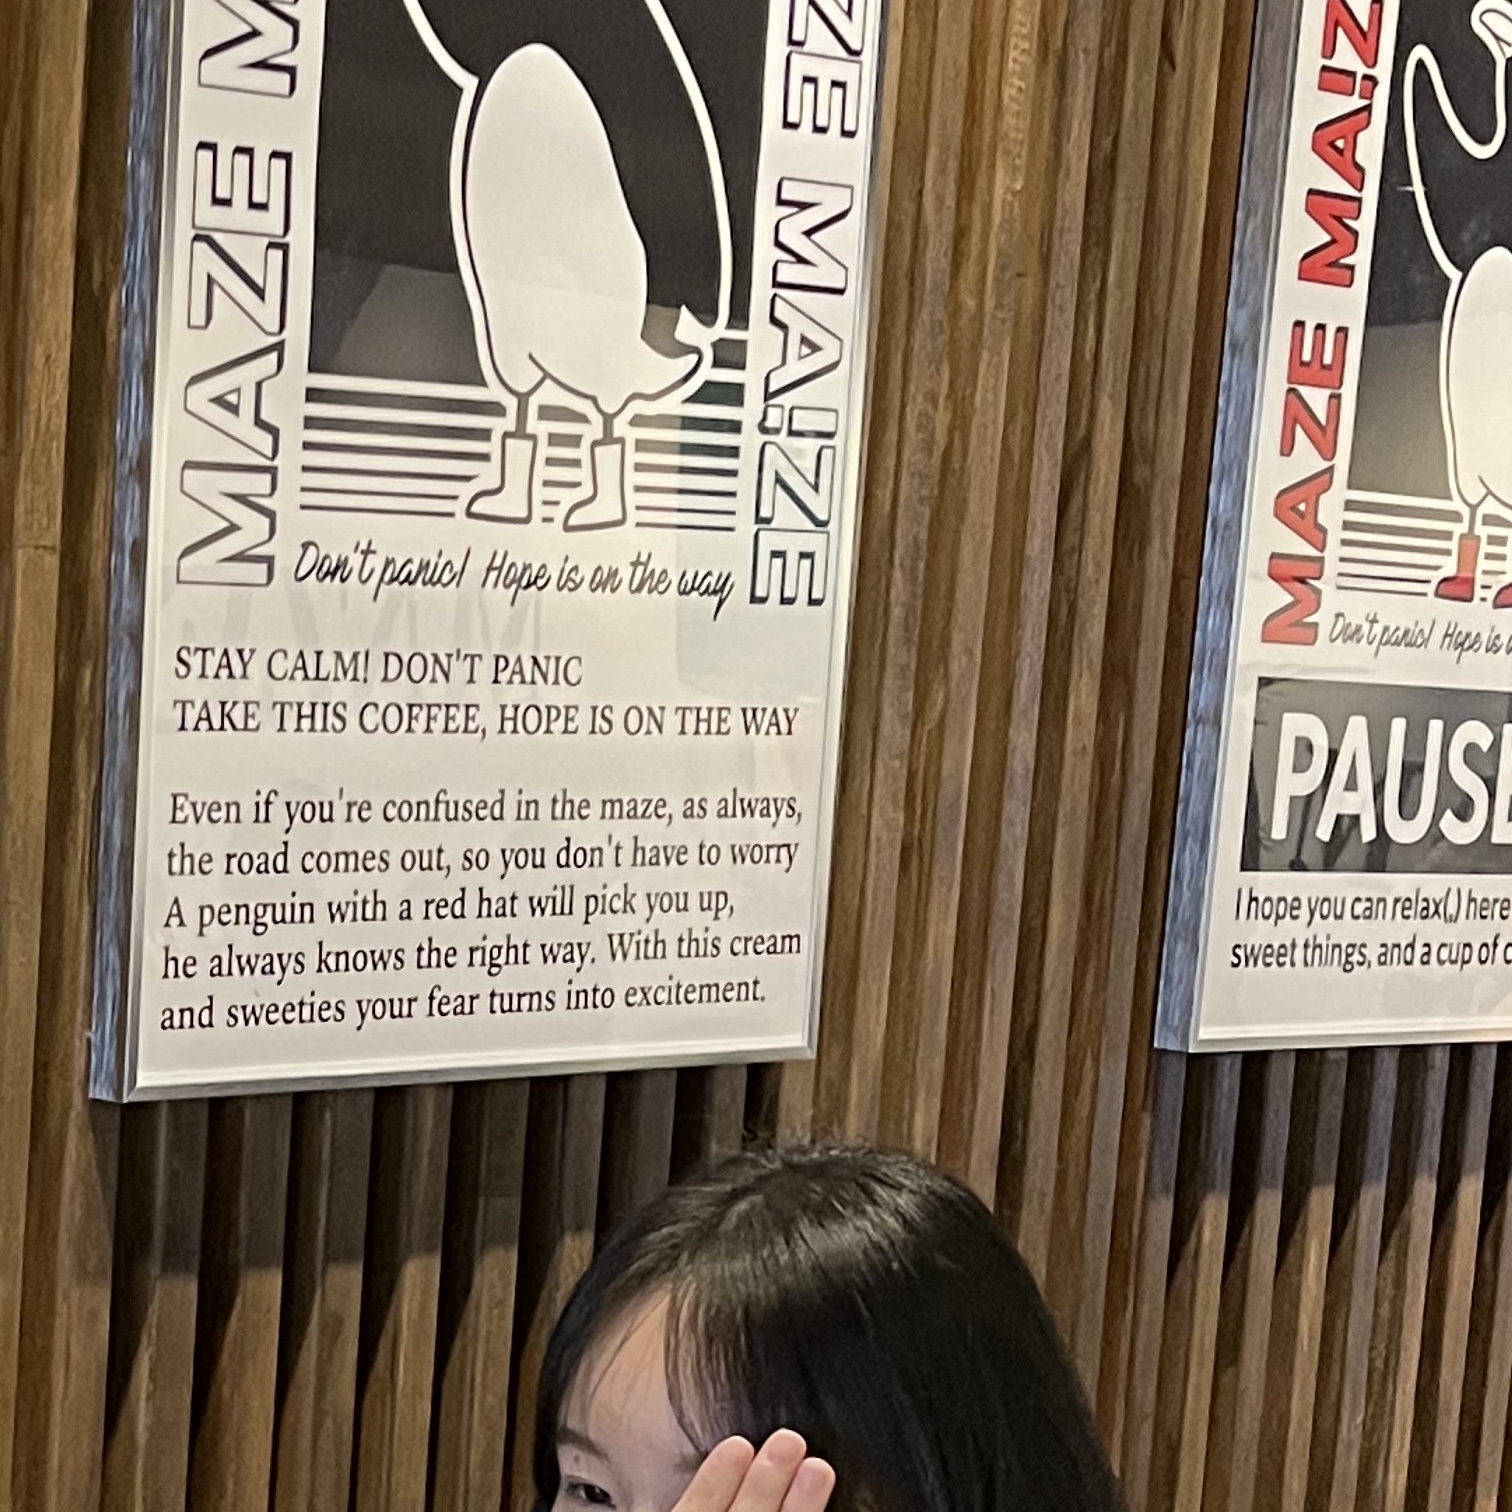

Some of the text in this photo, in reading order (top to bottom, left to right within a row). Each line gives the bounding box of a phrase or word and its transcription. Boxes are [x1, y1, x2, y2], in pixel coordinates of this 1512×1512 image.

[177, 141, 292, 588] MAZE
[1261, 320, 1349, 646] MAZE
[293, 539, 377, 585] Don't
[481, 549, 552, 607] Hope
[555, 555, 585, 593] is
[589, 567, 624, 595] on
[627, 550, 672, 597] the
[676, 568, 735, 622] way
[1328, 611, 1379, 645] Don't
[1440, 620, 1482, 664] Hope
[1485, 625, 1503, 654] is
[174, 646, 583, 687] STAY CALM! DON'T PANIC
[173, 700, 800, 743] TAKE THIS COFFEE, HOPE IS ON THE WAY
[169, 787, 803, 834] Even if you're confused in the maze, as always,
[167, 834, 799, 879] the road comes out, so you don't have to worry
[163, 882, 734, 937] A penguin with a red hat will pick you up,
[1235, 887, 1242, 920] I
[1246, 886, 1302, 927] hope
[1306, 896, 1346, 928] you
[1351, 896, 1387, 920] can
[1465, 888, 1511, 920] here
[162, 927, 802, 986] he always knows the right way. With this cream
[1231, 938, 1297, 968] sweet
[1303, 933, 1371, 973] things,
[1378, 933, 1417, 966] and
[1420, 942, 1431, 966] a
[1436, 942, 1473, 972] cup
[1478, 933, 1500, 965] of
[160, 975, 766, 1031] and sweeties your fear turns into excitement.
